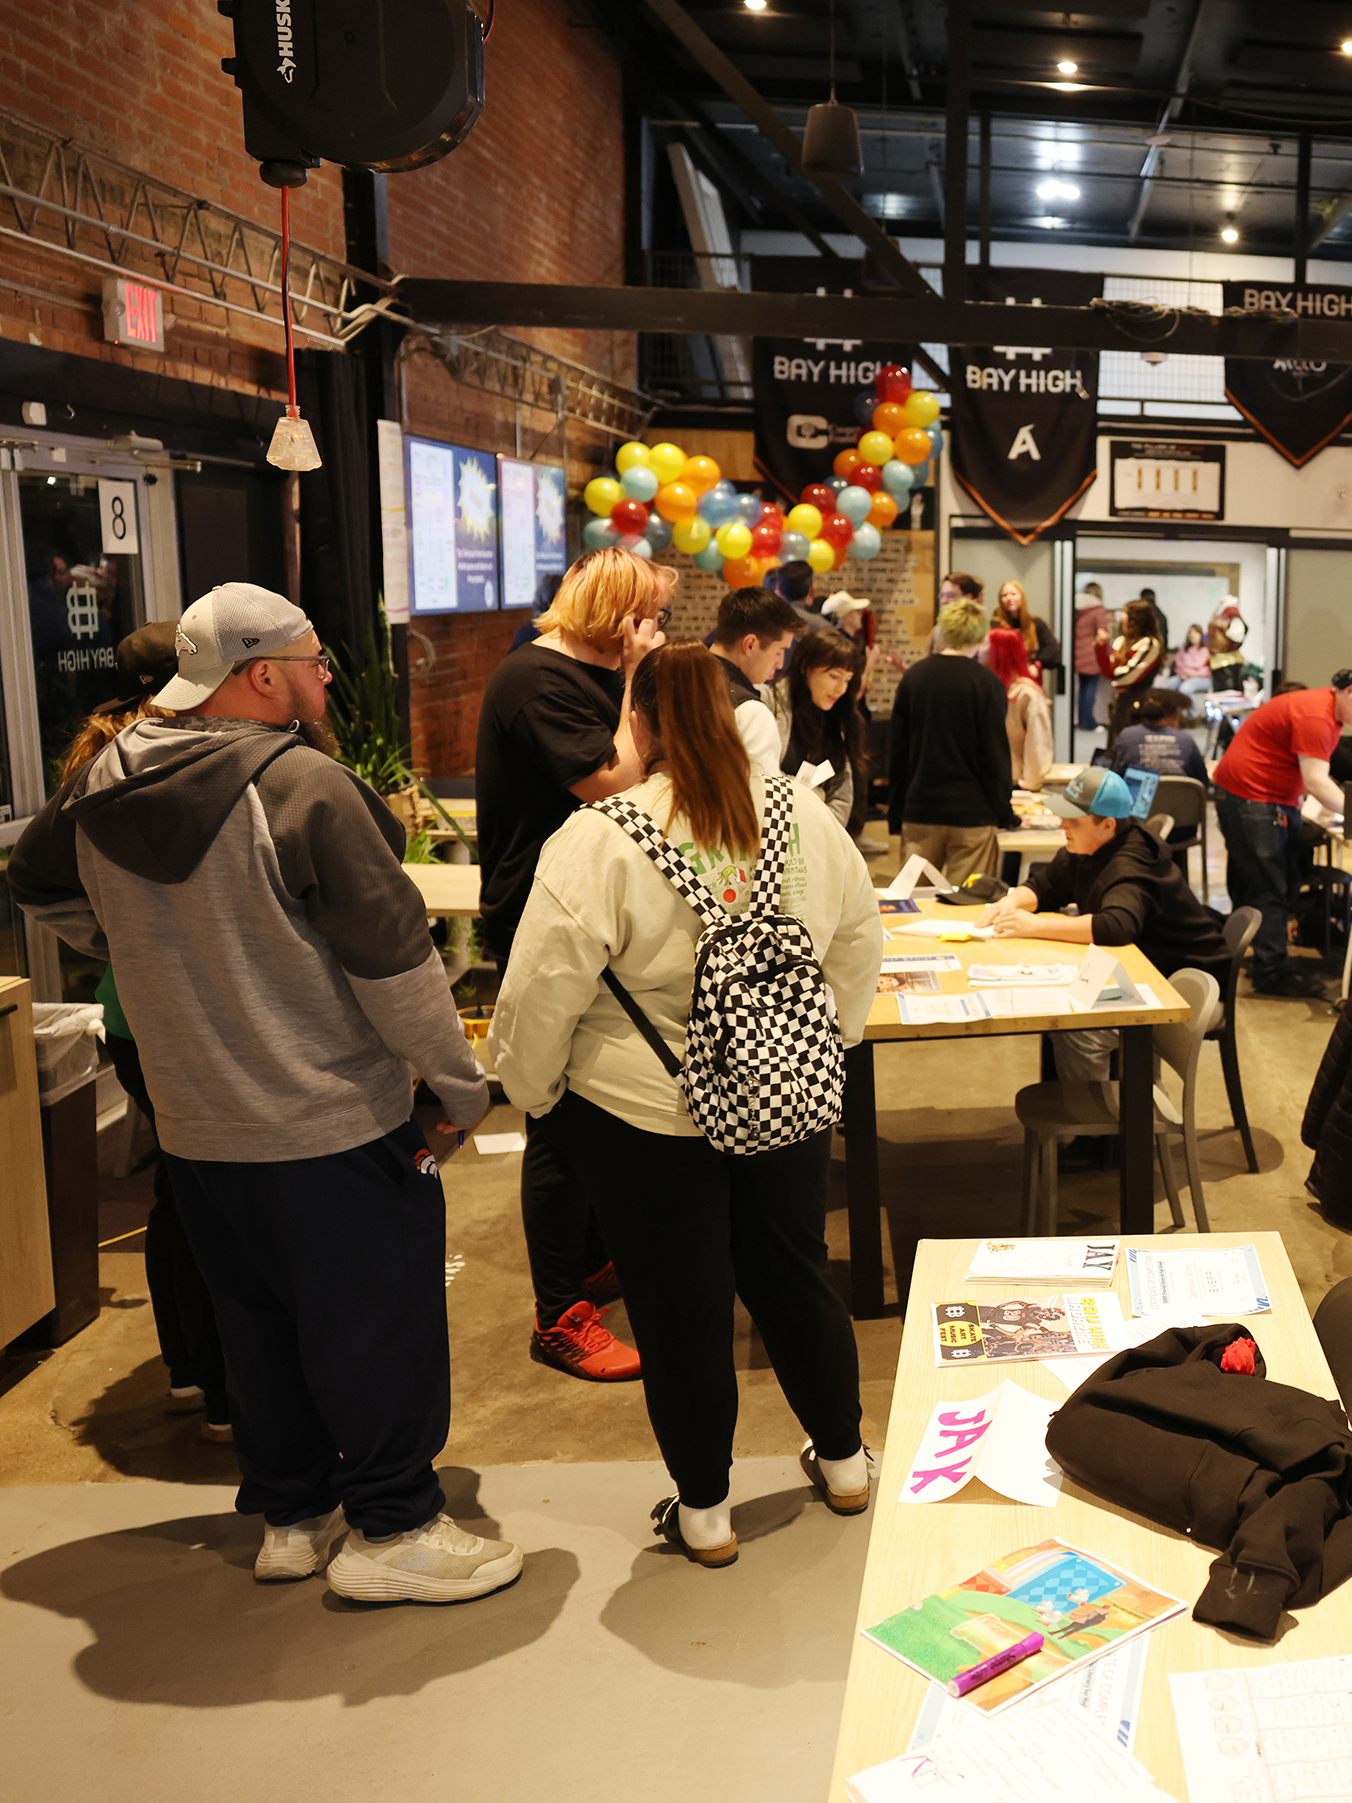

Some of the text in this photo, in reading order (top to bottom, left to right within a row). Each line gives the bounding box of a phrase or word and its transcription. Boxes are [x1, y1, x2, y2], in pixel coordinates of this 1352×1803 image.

[125, 283, 158, 343] EXIT
[1243, 288, 1294, 312] BAY
[773, 355, 826, 383] BAY
[965, 364, 1083, 393] BAY HIGH
[111, 496, 126, 540] 8
[1082, 1243, 1116, 1271] JAY
[949, 1325, 957, 1343] MUSIC
[959, 1328, 967, 1340] ART
[968, 1324, 977, 1343] SKATE
[1080, 1297, 1110, 1350] BAY HIGH
[910, 1409, 993, 1495] JAK
